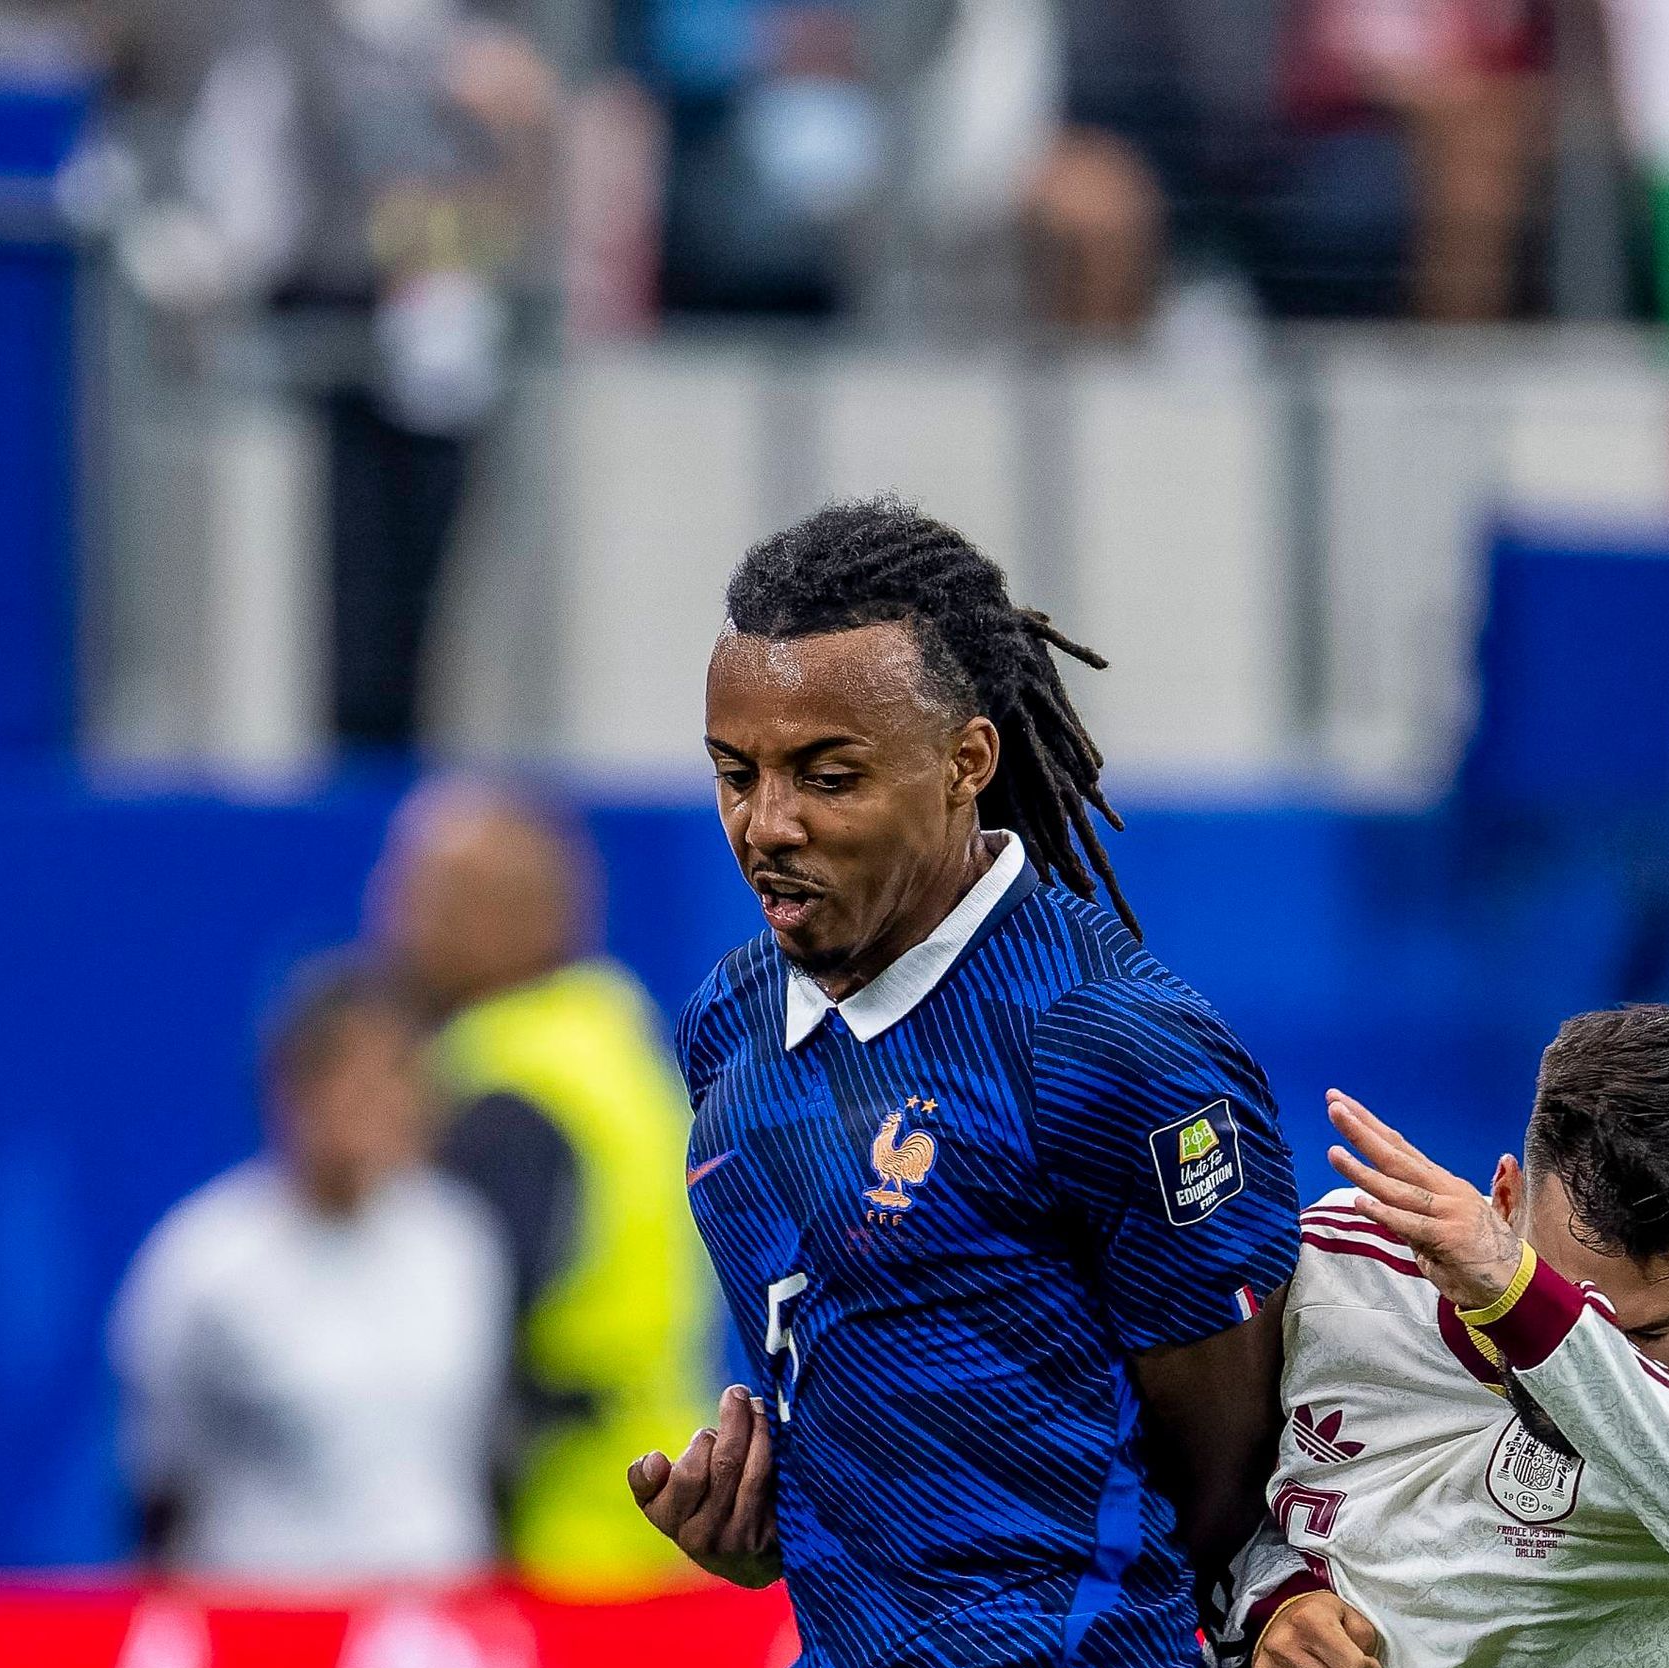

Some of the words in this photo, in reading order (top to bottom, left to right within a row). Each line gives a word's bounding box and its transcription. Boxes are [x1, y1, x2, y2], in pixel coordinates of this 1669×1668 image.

[1175, 1162, 1233, 1206] EDUCATION
[1199, 1191, 1218, 1211] FIFA
[1496, 1525, 1527, 1537] FRANCE
[1529, 1528, 1540, 1538] VS
[1536, 1539, 1558, 1549] 2026
[1515, 1547, 1547, 1559] DALLAS
